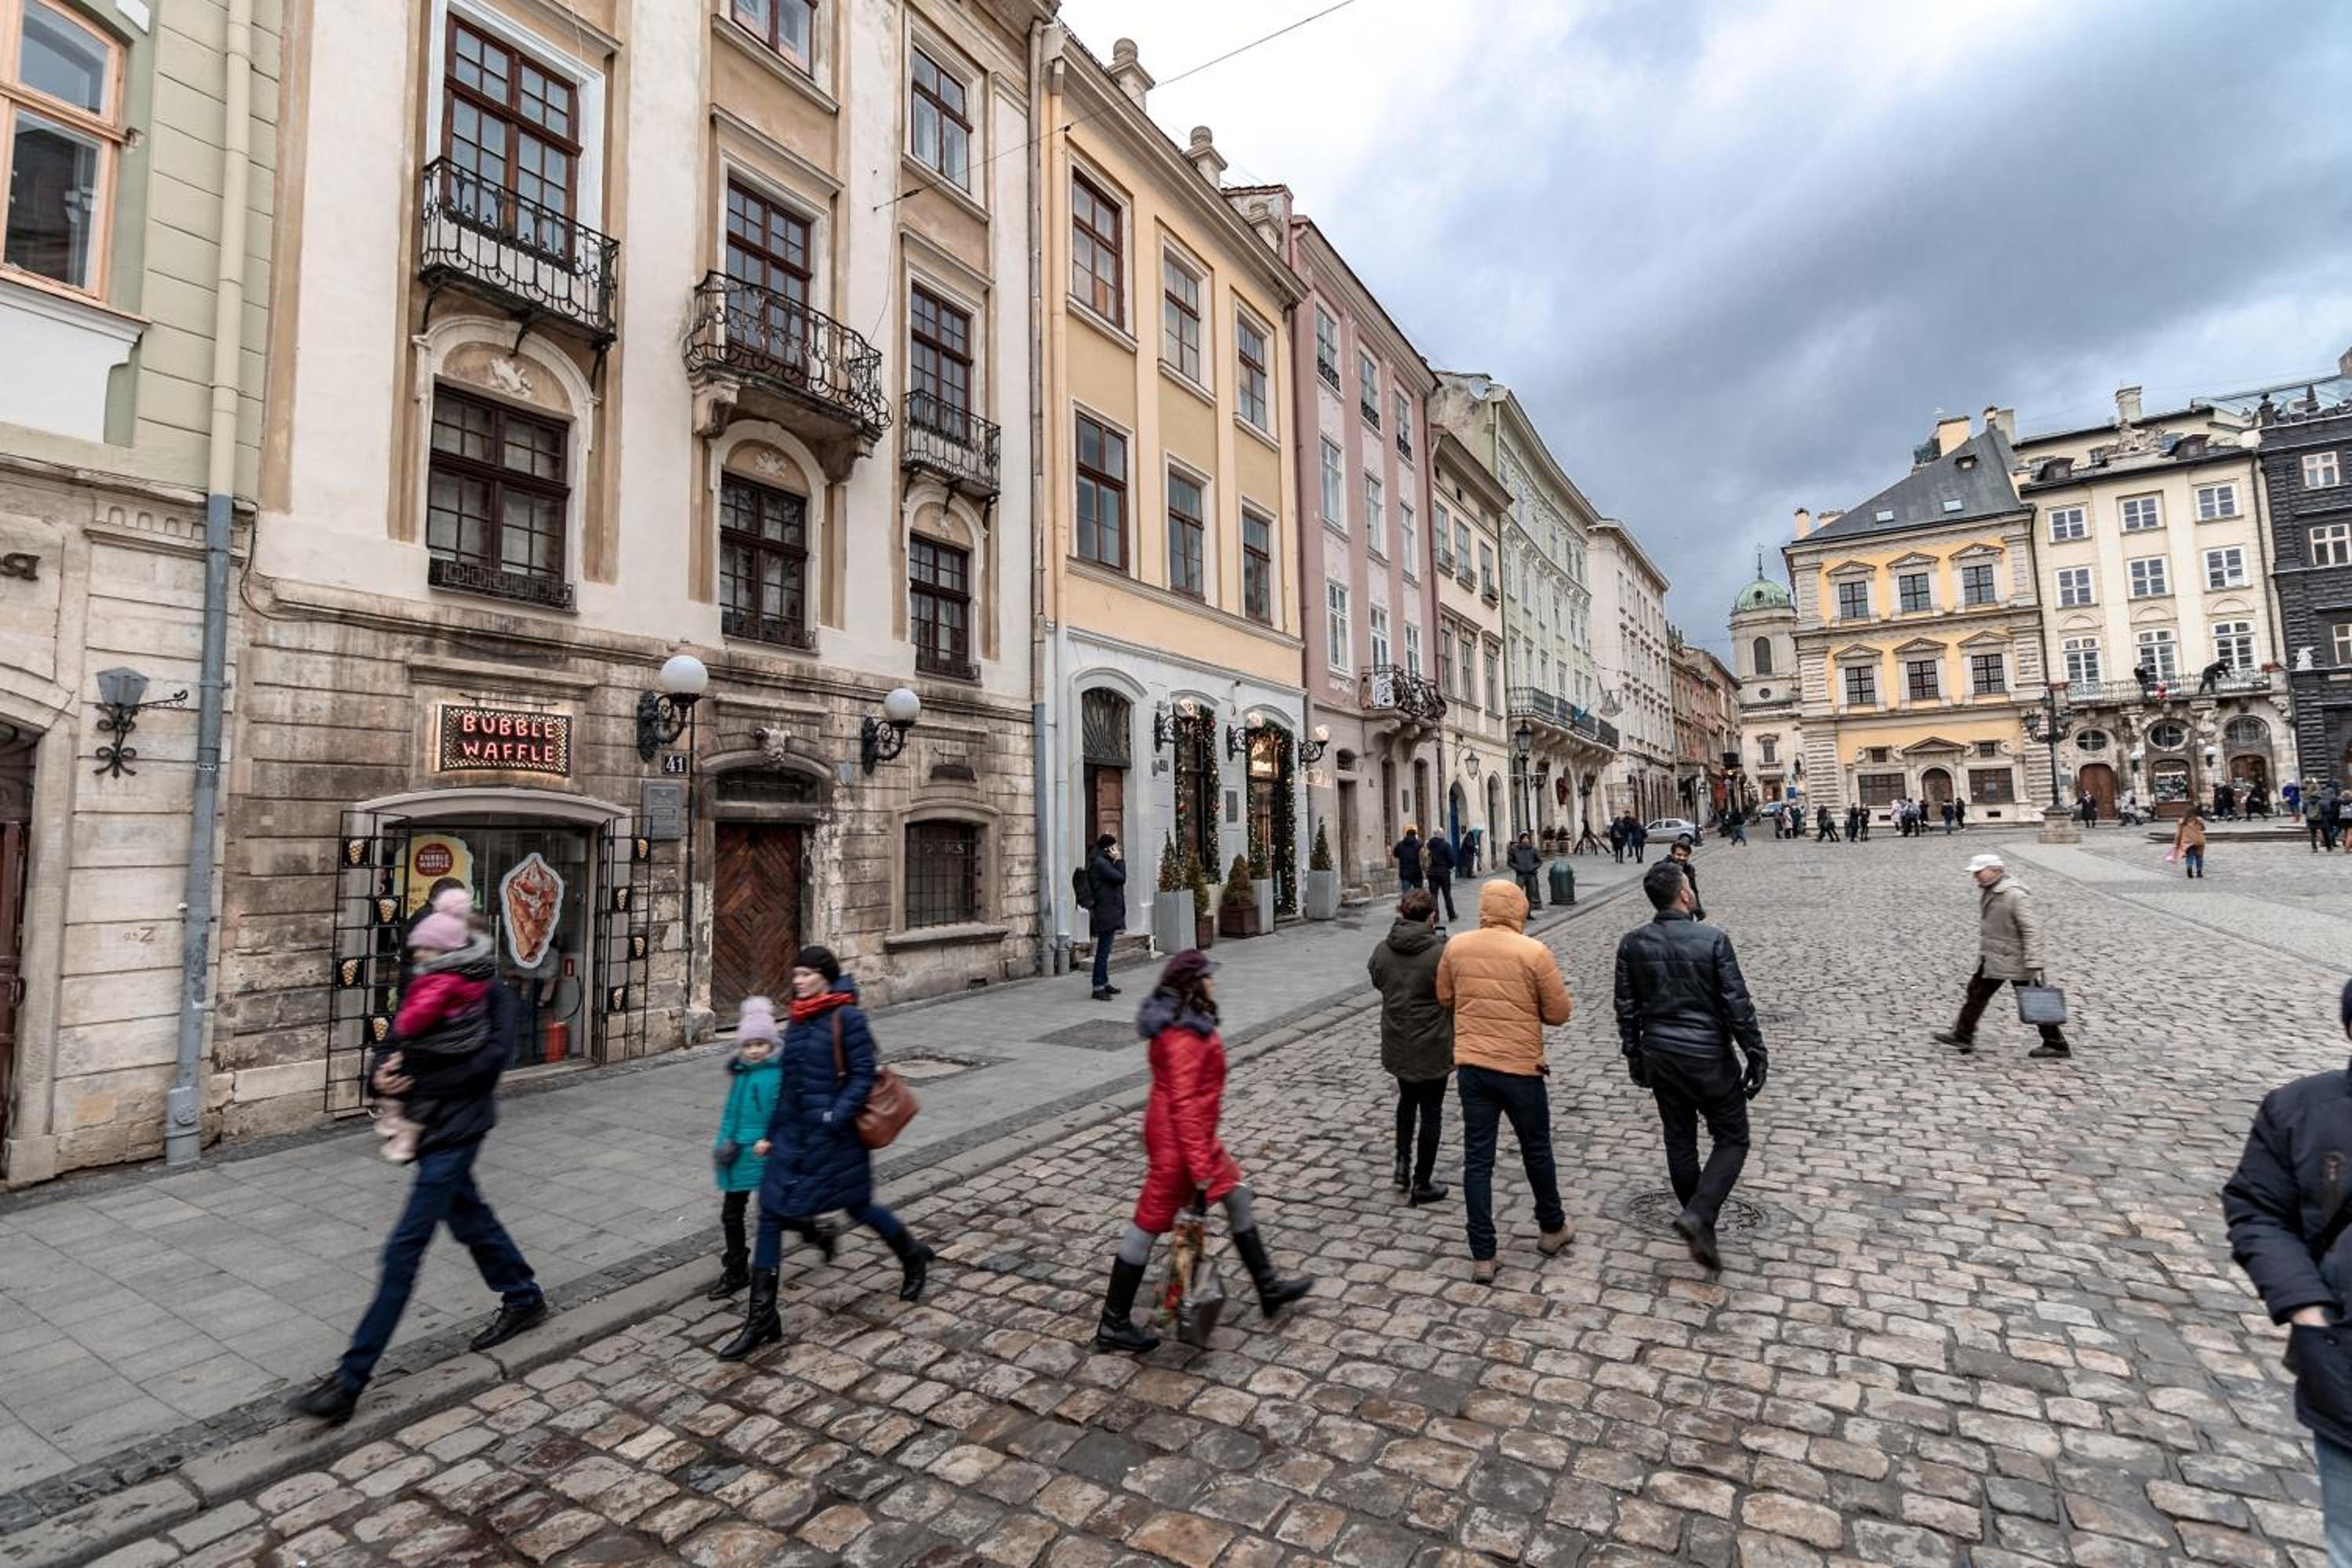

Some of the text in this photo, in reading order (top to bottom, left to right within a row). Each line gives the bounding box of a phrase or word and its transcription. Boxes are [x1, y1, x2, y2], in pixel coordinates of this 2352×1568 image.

[463, 713, 555, 739] BUBBLE
[463, 741, 555, 762] WAFFLE
[666, 755, 684, 772] 41
